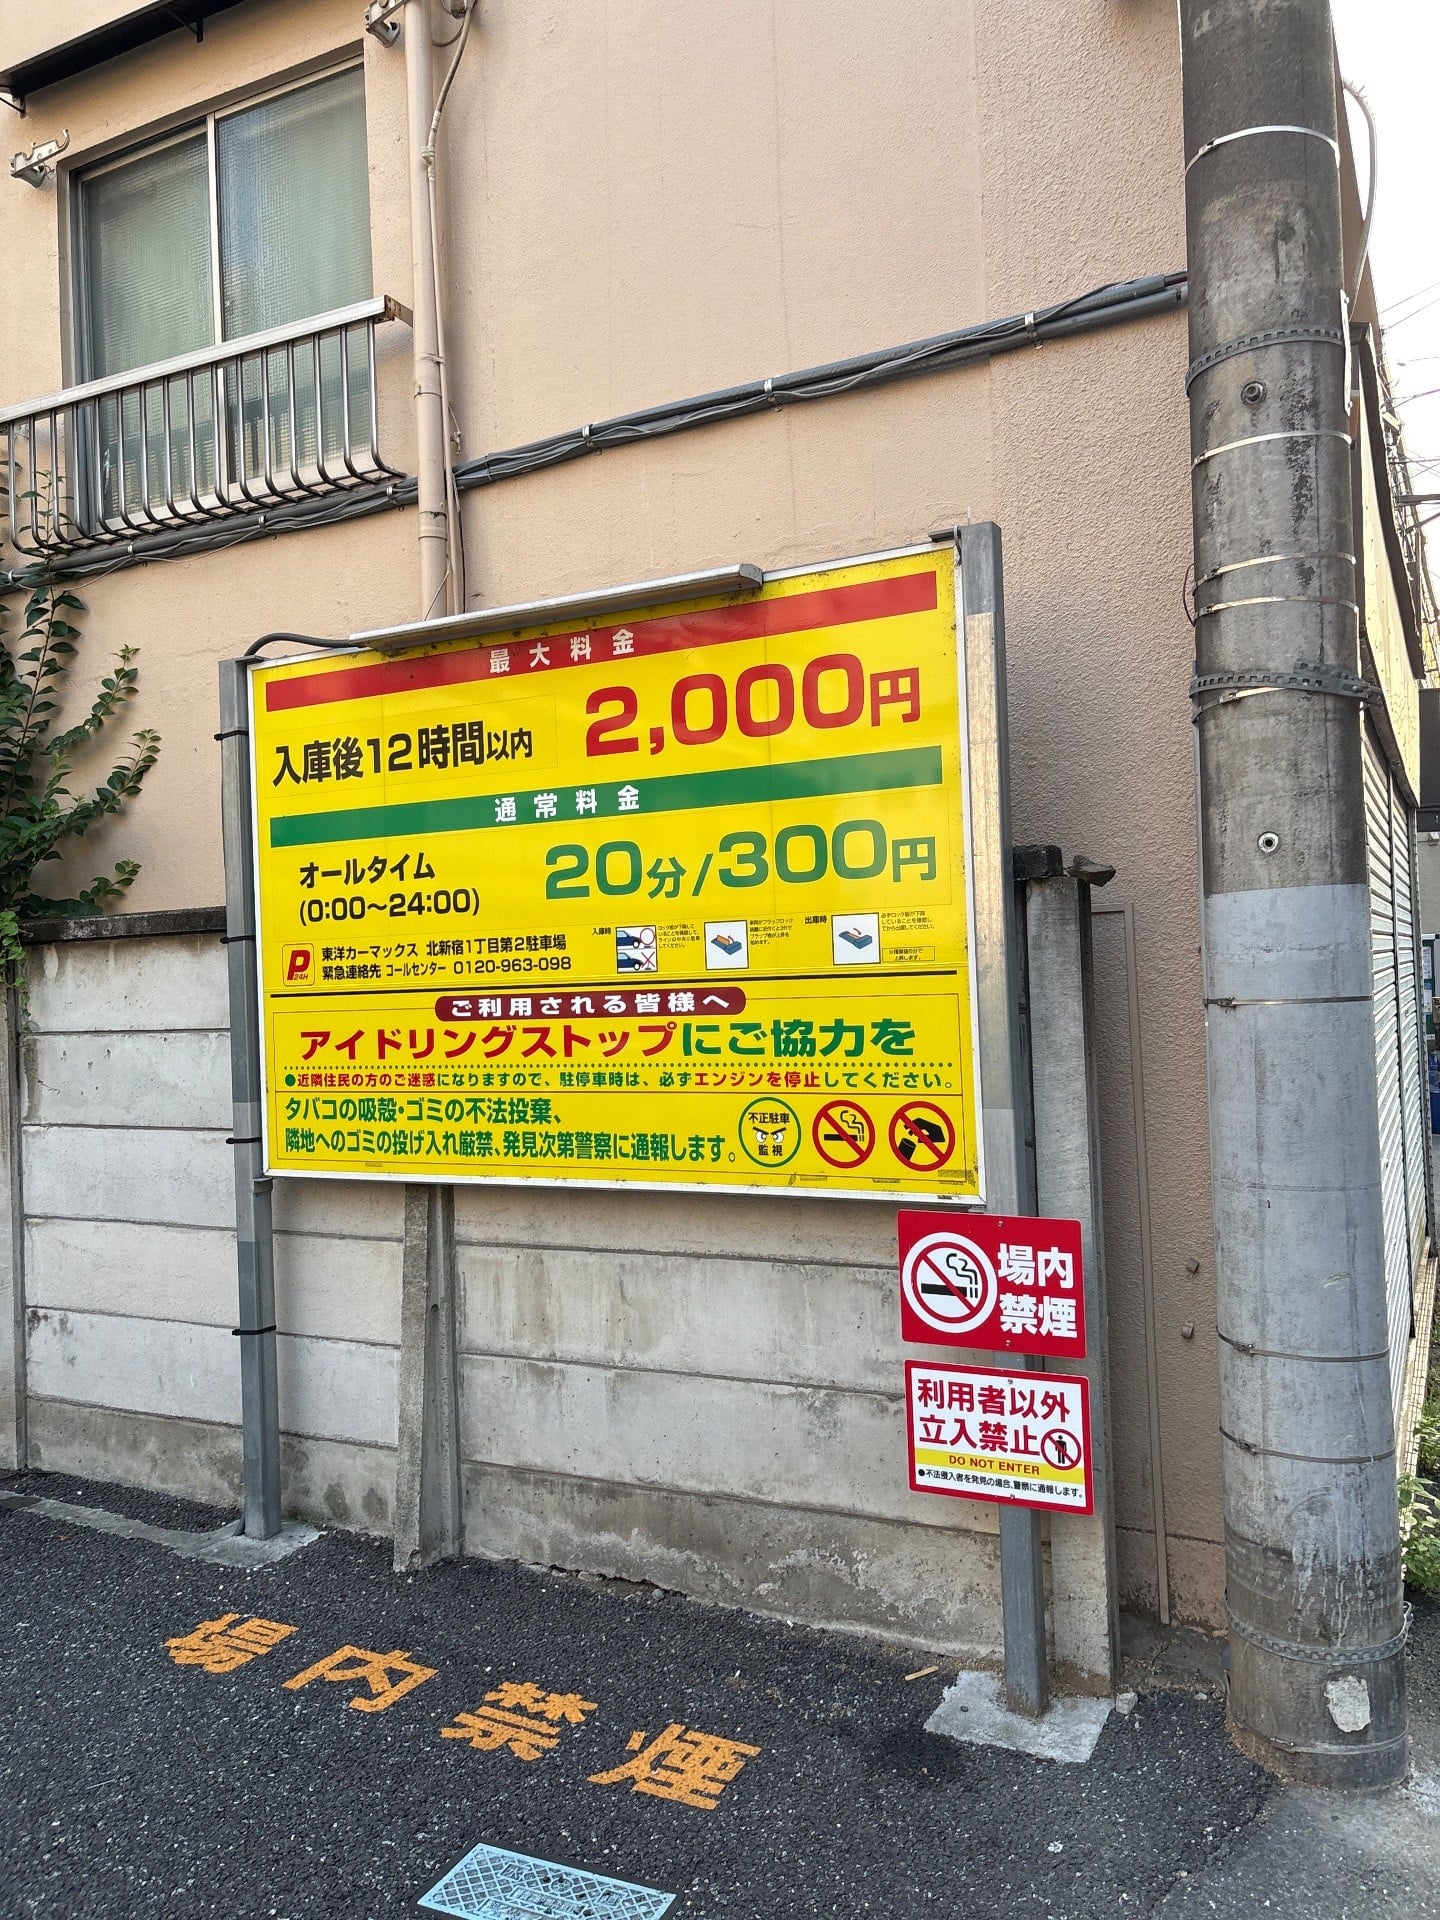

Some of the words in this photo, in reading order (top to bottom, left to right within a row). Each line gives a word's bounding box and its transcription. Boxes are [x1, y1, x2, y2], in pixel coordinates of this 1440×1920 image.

[489, 628, 635, 674] 最大料金
[586, 653, 920, 757] 2,000円
[272, 720, 533, 787] 入庫後12時間以内
[495, 785, 640, 822] 通常料金
[299, 852, 436, 888] オールタイム
[545, 819, 936, 900] 20分/300円
[321, 943, 419, 962] 東洋カーマックス
[426, 934, 567, 957] 北新宿1丁目第2駐車場
[321, 964, 382, 981] 緊急連絡先
[385, 962, 446, 978] コールセンター
[453, 957, 572, 975] 0120-963-098
[451, 992, 730, 1018] ご利用される皆様へ
[299, 1018, 916, 1060] アイドリングストップにご協力を
[284, 1097, 562, 1125] タバコの吸殻・ゴミの不法投棄、
[748, 1112, 790, 1124] 不正駐車
[284, 1127, 736, 1163] 隣地へのゴミの投げ入れ厳禁、発見次第警察に通報します。
[758, 1144, 783, 1157] 監視
[997, 1242, 1075, 1289] 場内
[999, 1292, 1078, 1339] 禁煙
[917, 1378, 1070, 1423] 利用者以外
[919, 1414, 1041, 1456] 立入禁止
[948, 1454, 966, 1466] DO
[969, 1457, 995, 1471] NOT
[998, 1460, 1040, 1476] ENTER
[163, 1612, 762, 1810] 場内禁煙
